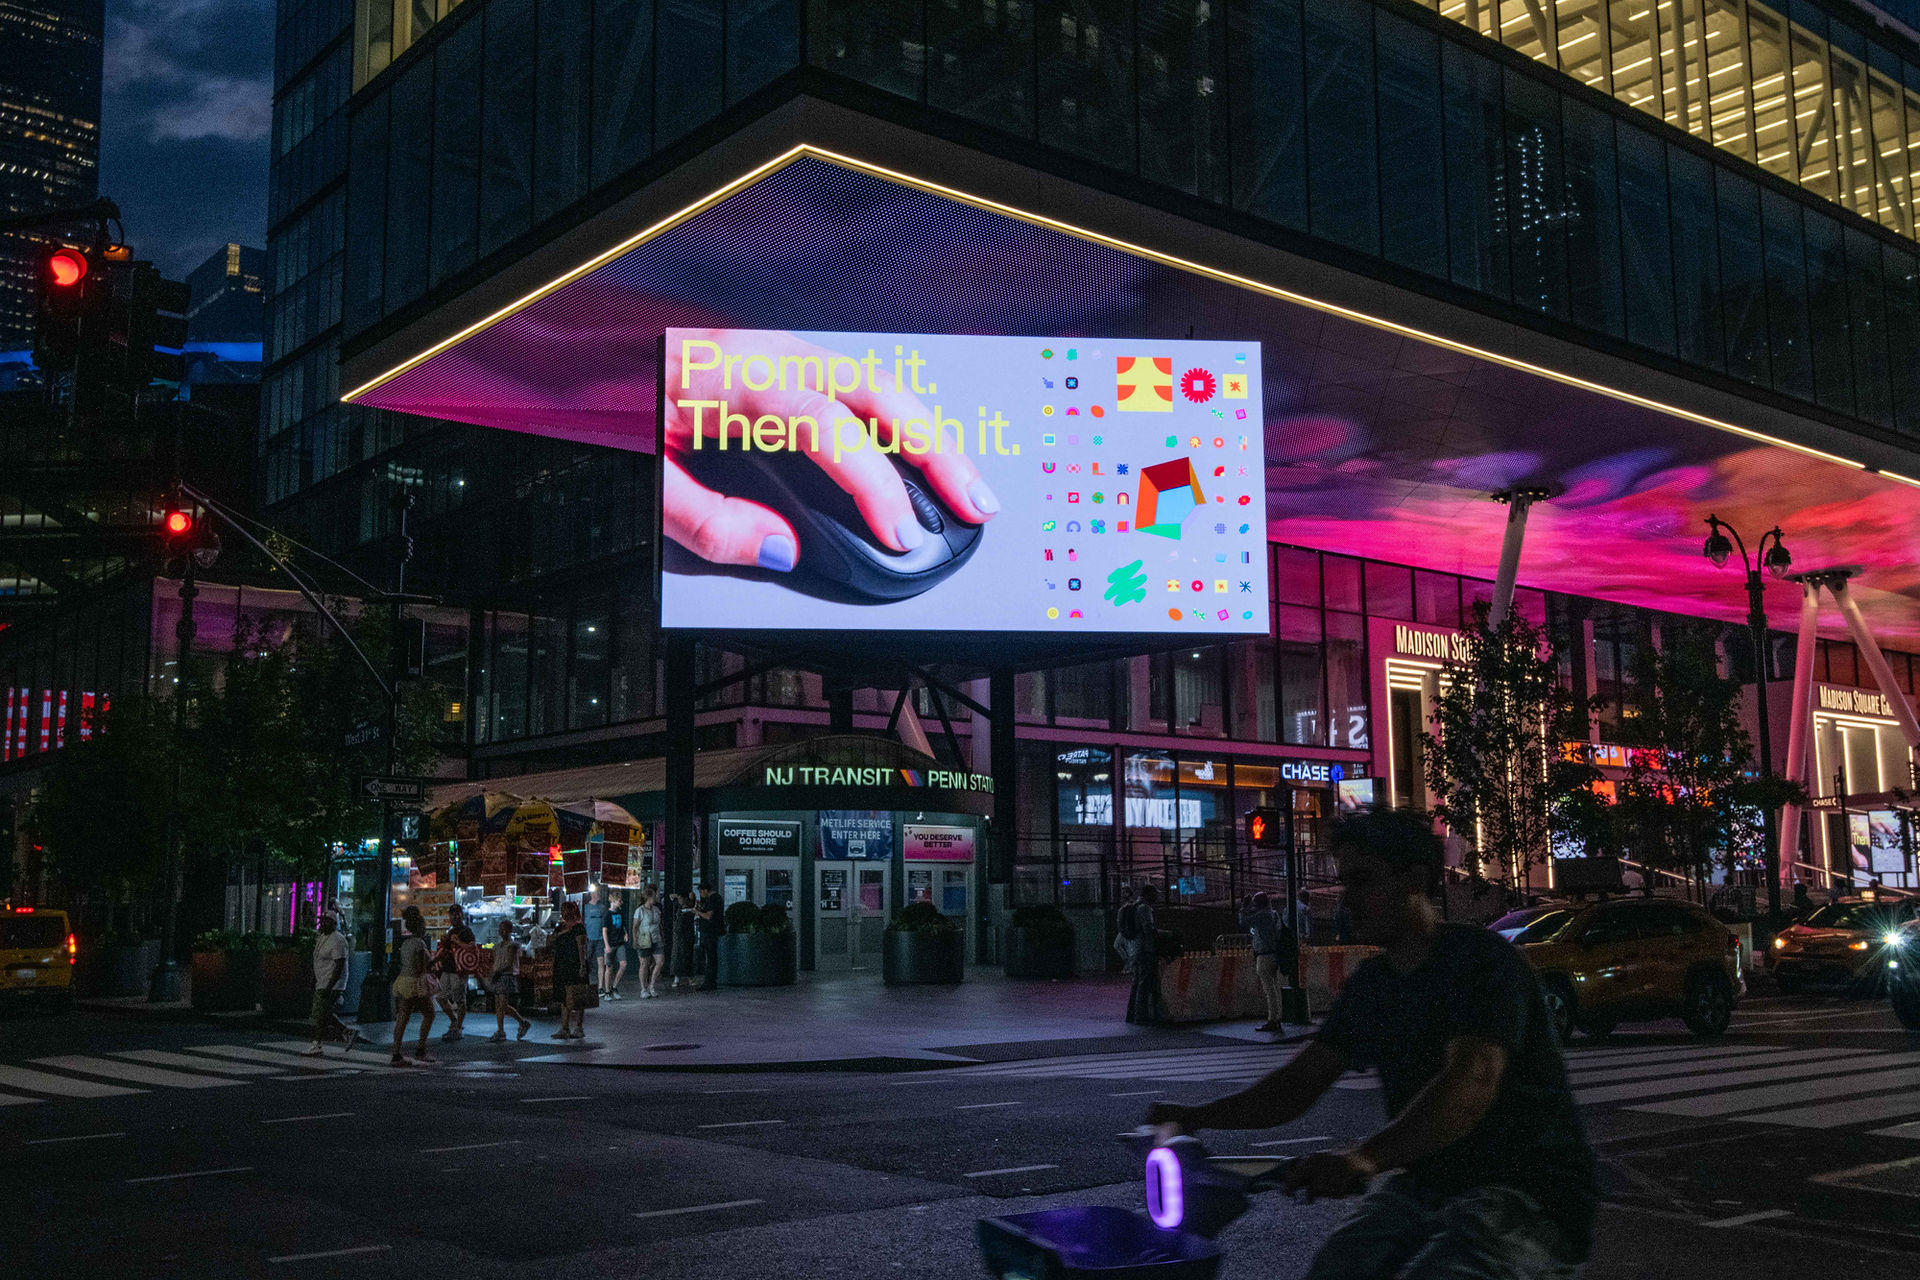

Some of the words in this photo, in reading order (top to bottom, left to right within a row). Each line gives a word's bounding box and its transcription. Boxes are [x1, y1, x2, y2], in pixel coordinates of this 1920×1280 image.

[681, 339, 883, 402] Prompt
[895, 345, 937, 394] it.
[677, 400, 819, 452] Then
[833, 405, 964, 463] push
[978, 406, 1021, 455] it.
[1396, 624, 1449, 659] MADISON
[1819, 685, 1853, 711] MADISON
[1853, 689, 1880, 715] SQUARE
[1282, 763, 1330, 781] CHASE
[766, 767, 793, 786] NJ
[800, 767, 895, 786] TRANSIT
[928, 770, 967, 790] PENN
[970, 775, 994, 794] STATIO
[371, 783, 387, 793] ONE
[394, 784, 413, 793] WAY
[820, 818, 856, 829] METLIFE
[858, 818, 892, 829] SERVICE
[723, 829, 758, 838] COFFEE
[758, 829, 792, 838] SHOULD
[831, 830, 857, 840] ENTER
[860, 830, 881, 840] HERE
[913, 833, 929, 841] YOU
[930, 833, 963, 841] DESERVE
[739, 837, 752, 845] DO
[753, 837, 777, 846] MORE
[923, 840, 953, 848] BETTER
